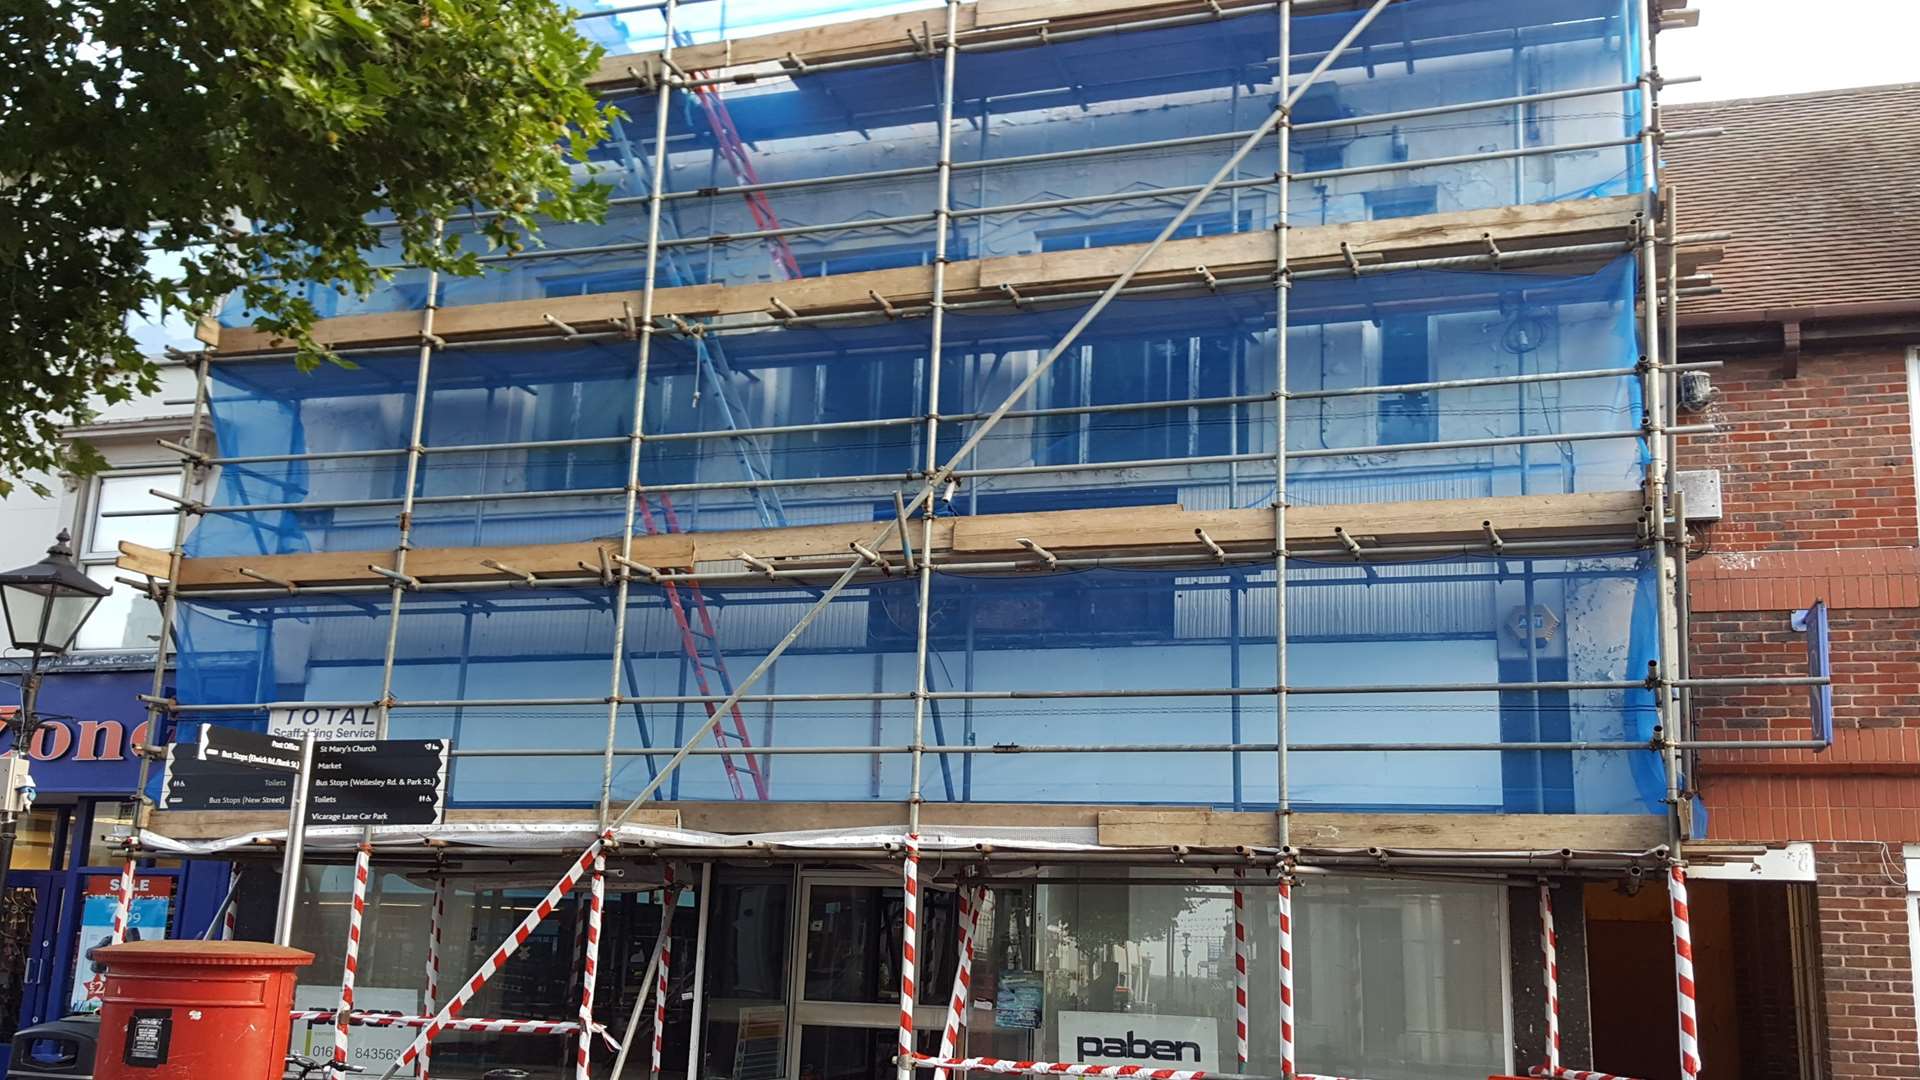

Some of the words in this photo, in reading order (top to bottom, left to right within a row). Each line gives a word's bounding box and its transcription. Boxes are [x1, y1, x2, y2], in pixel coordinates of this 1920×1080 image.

[1519, 616, 1543, 626] AT
[286, 707, 375, 725] TOTAL
[335, 727, 376, 739] Service
[272, 740, 284, 749] Post
[284, 742, 300, 751] Office
[329, 745, 351, 754] Mary's
[353, 745, 377, 753] Church
[221, 750, 232, 759] Bus
[233, 751, 248, 762] Stops
[317, 762, 342, 770] Market
[265, 779, 287, 787] Toilets
[329, 779, 348, 787] Stops
[349, 778, 385, 787] (Wellesley
[407, 778, 422, 786] Park
[423, 778, 436, 787] St.)
[208, 796, 221, 804] Bus
[222, 796, 241, 805] Stops
[242, 796, 261, 804] (New
[262, 796, 286, 804] Street)
[311, 813, 341, 821] Vicarage
[372, 812, 388, 820] Park
[110, 878, 150, 891] SLE
[1076, 1030, 1201, 1062] paben
[354, 1047, 401, 1060] 843563
